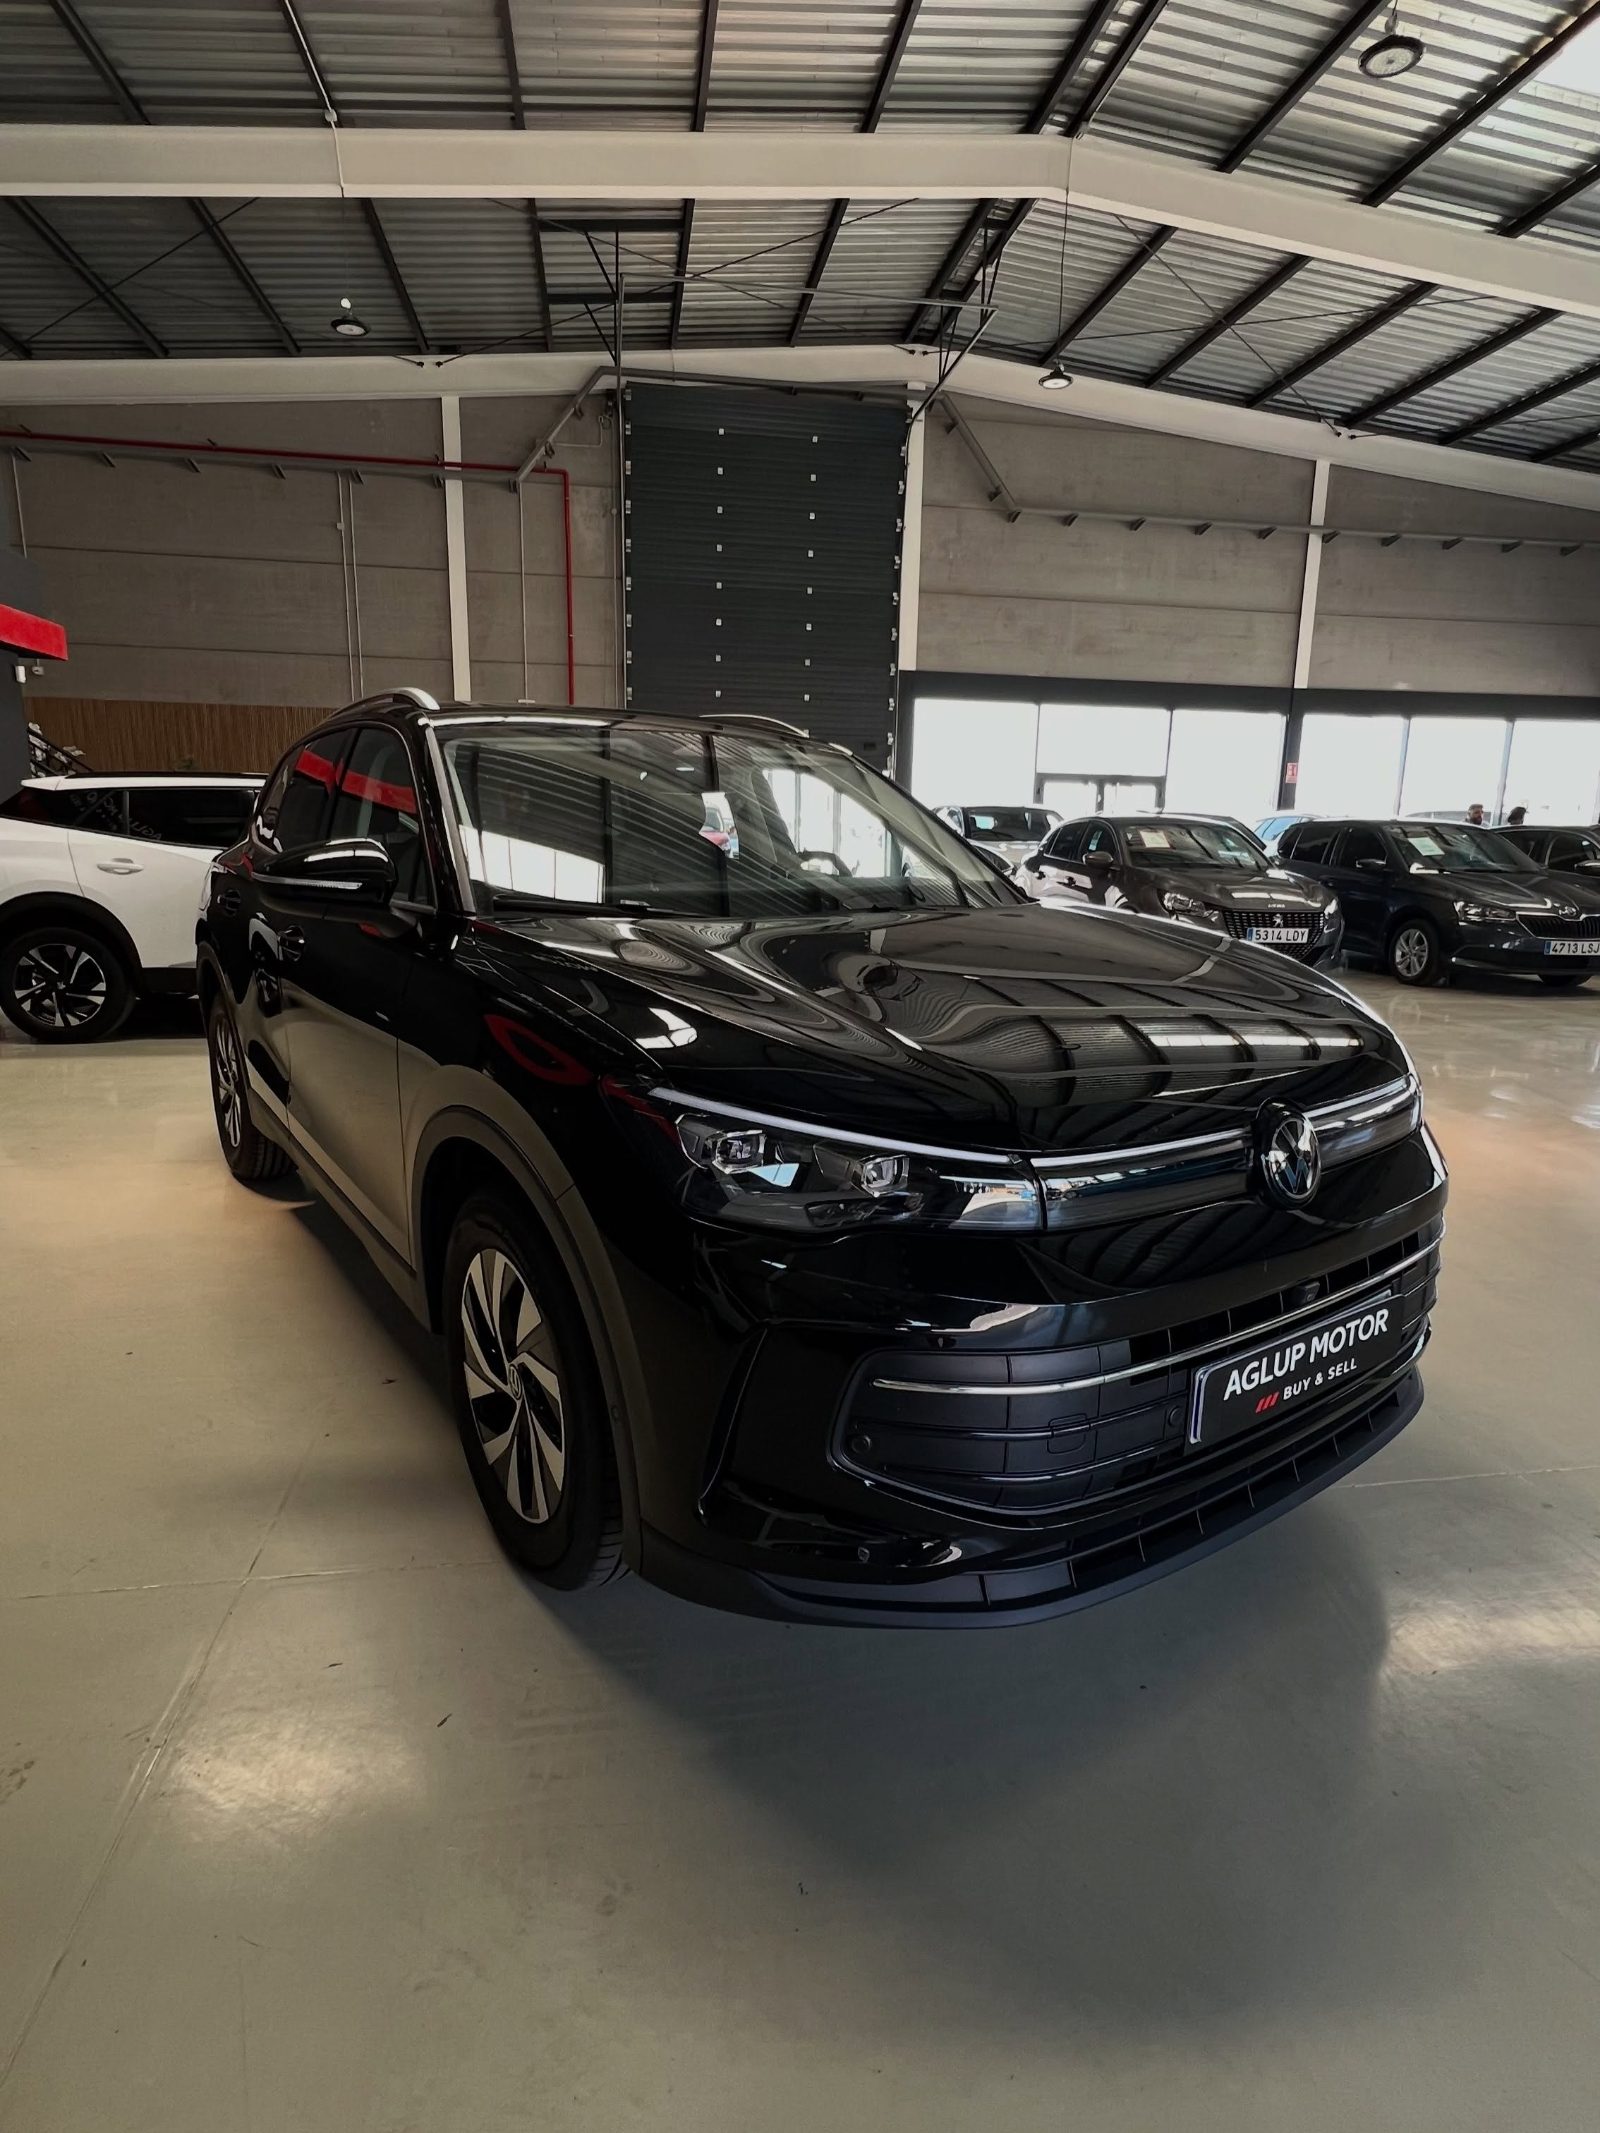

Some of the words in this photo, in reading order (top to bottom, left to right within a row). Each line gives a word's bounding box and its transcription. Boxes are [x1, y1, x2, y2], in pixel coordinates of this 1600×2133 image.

[1255, 929, 1282, 941] 5314
[1286, 930, 1307, 942] LDY
[1551, 942, 1579, 954] 4713
[1581, 943, 1600, 954] LSJ
[1223, 1342, 1306, 1401] AGLUP
[1309, 1308, 1390, 1364] MOTOR
[1283, 1376, 1312, 1400] BUY
[1314, 1372, 1324, 1386] &
[1327, 1358, 1357, 1380] SELL
